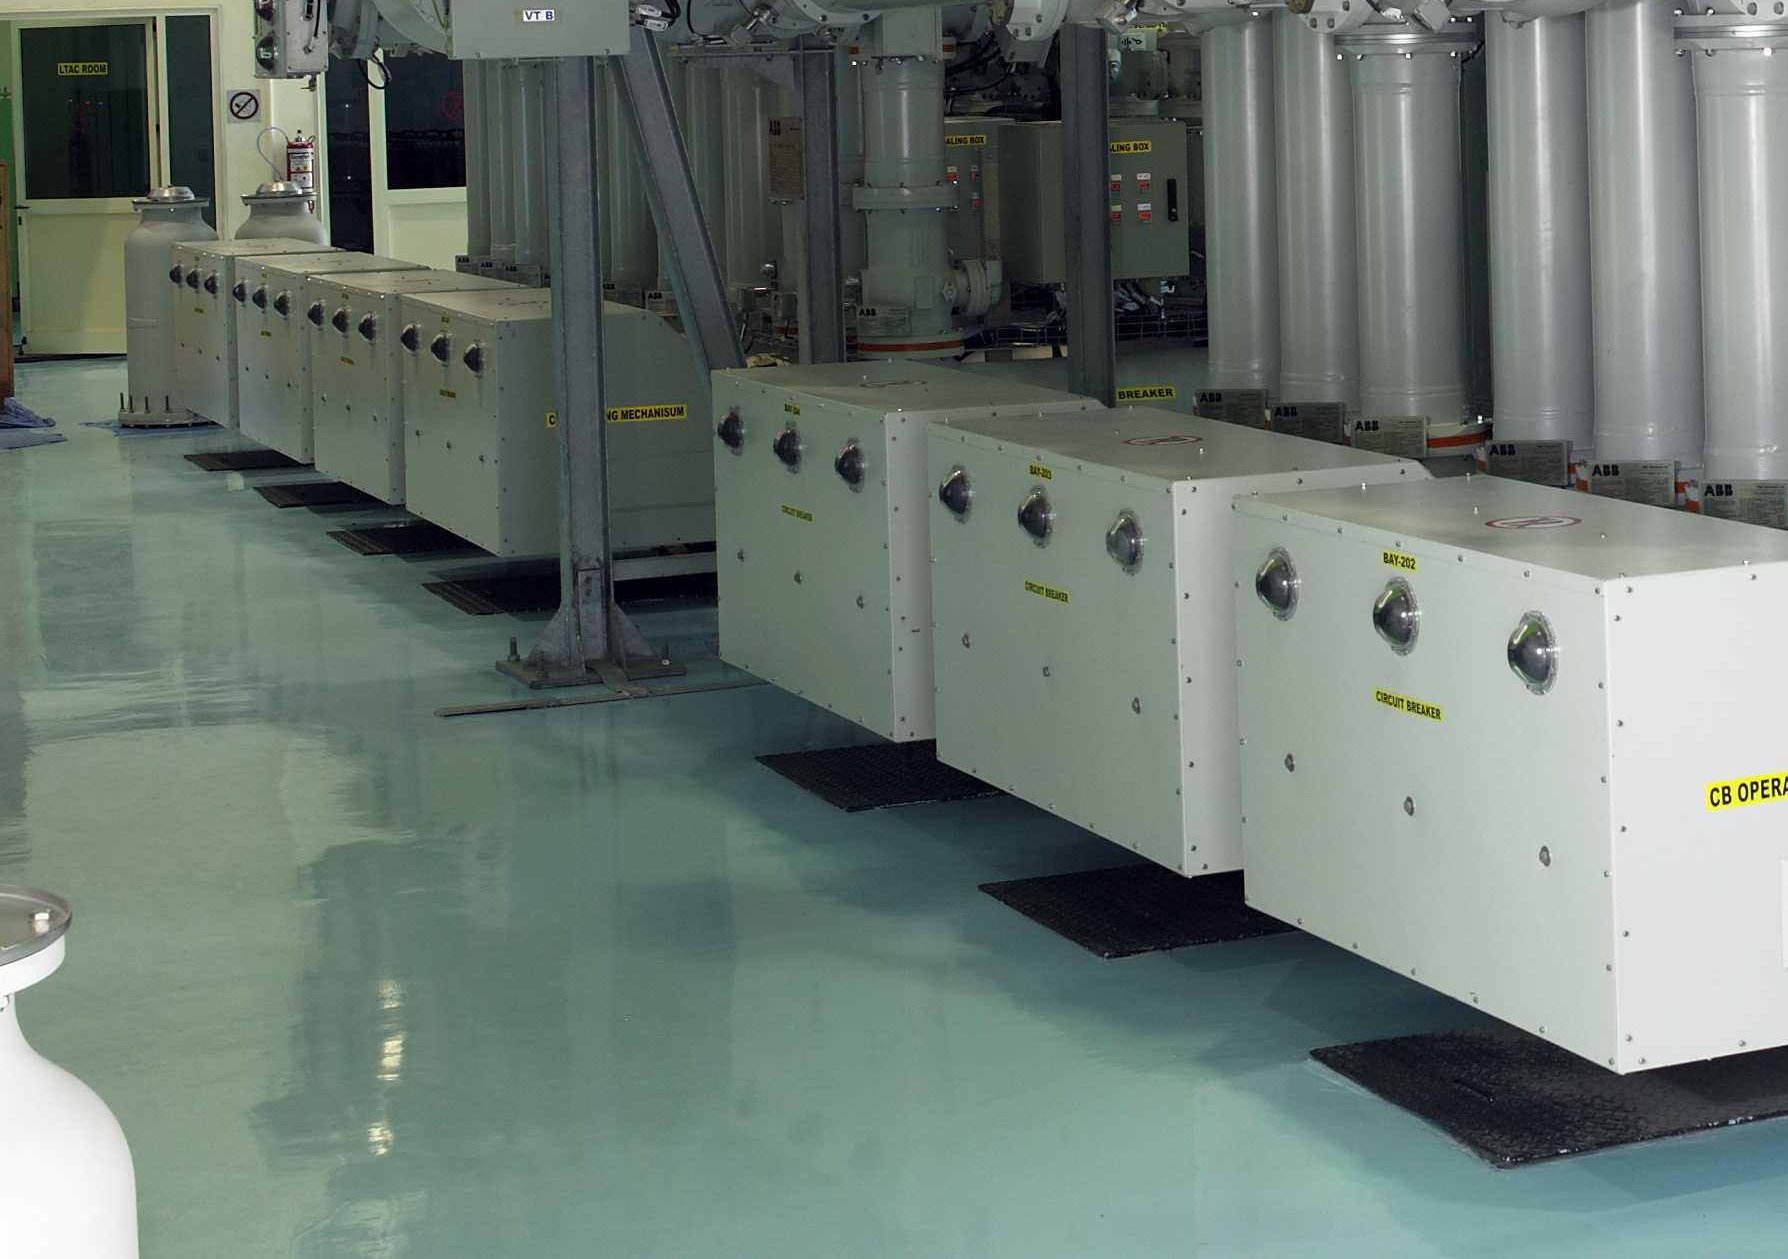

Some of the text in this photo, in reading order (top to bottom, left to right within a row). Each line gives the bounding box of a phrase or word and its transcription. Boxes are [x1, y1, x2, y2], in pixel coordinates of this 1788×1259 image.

[525, 11, 553, 21] VT B
[59, 63, 107, 73] LTAC ROOM
[945, 136, 968, 145] ALING
[1133, 143, 1149, 151] BOX
[1118, 387, 1174, 400] BREAKER
[1199, 392, 1222, 402] ABB
[621, 406, 685, 421] MECHANISUM
[1274, 406, 1297, 417] ABB
[1355, 420, 1379, 431] ABB
[1489, 444, 1516, 456] ABB
[1592, 464, 1620, 476] ABB
[1703, 484, 1733, 497] ABB
[1382, 551, 1417, 571] BAY-202
[1045, 587, 1069, 604] BREAKER
[1375, 690, 1441, 721] CIRCUIT BREAKER
[1709, 783, 1734, 807] CB
